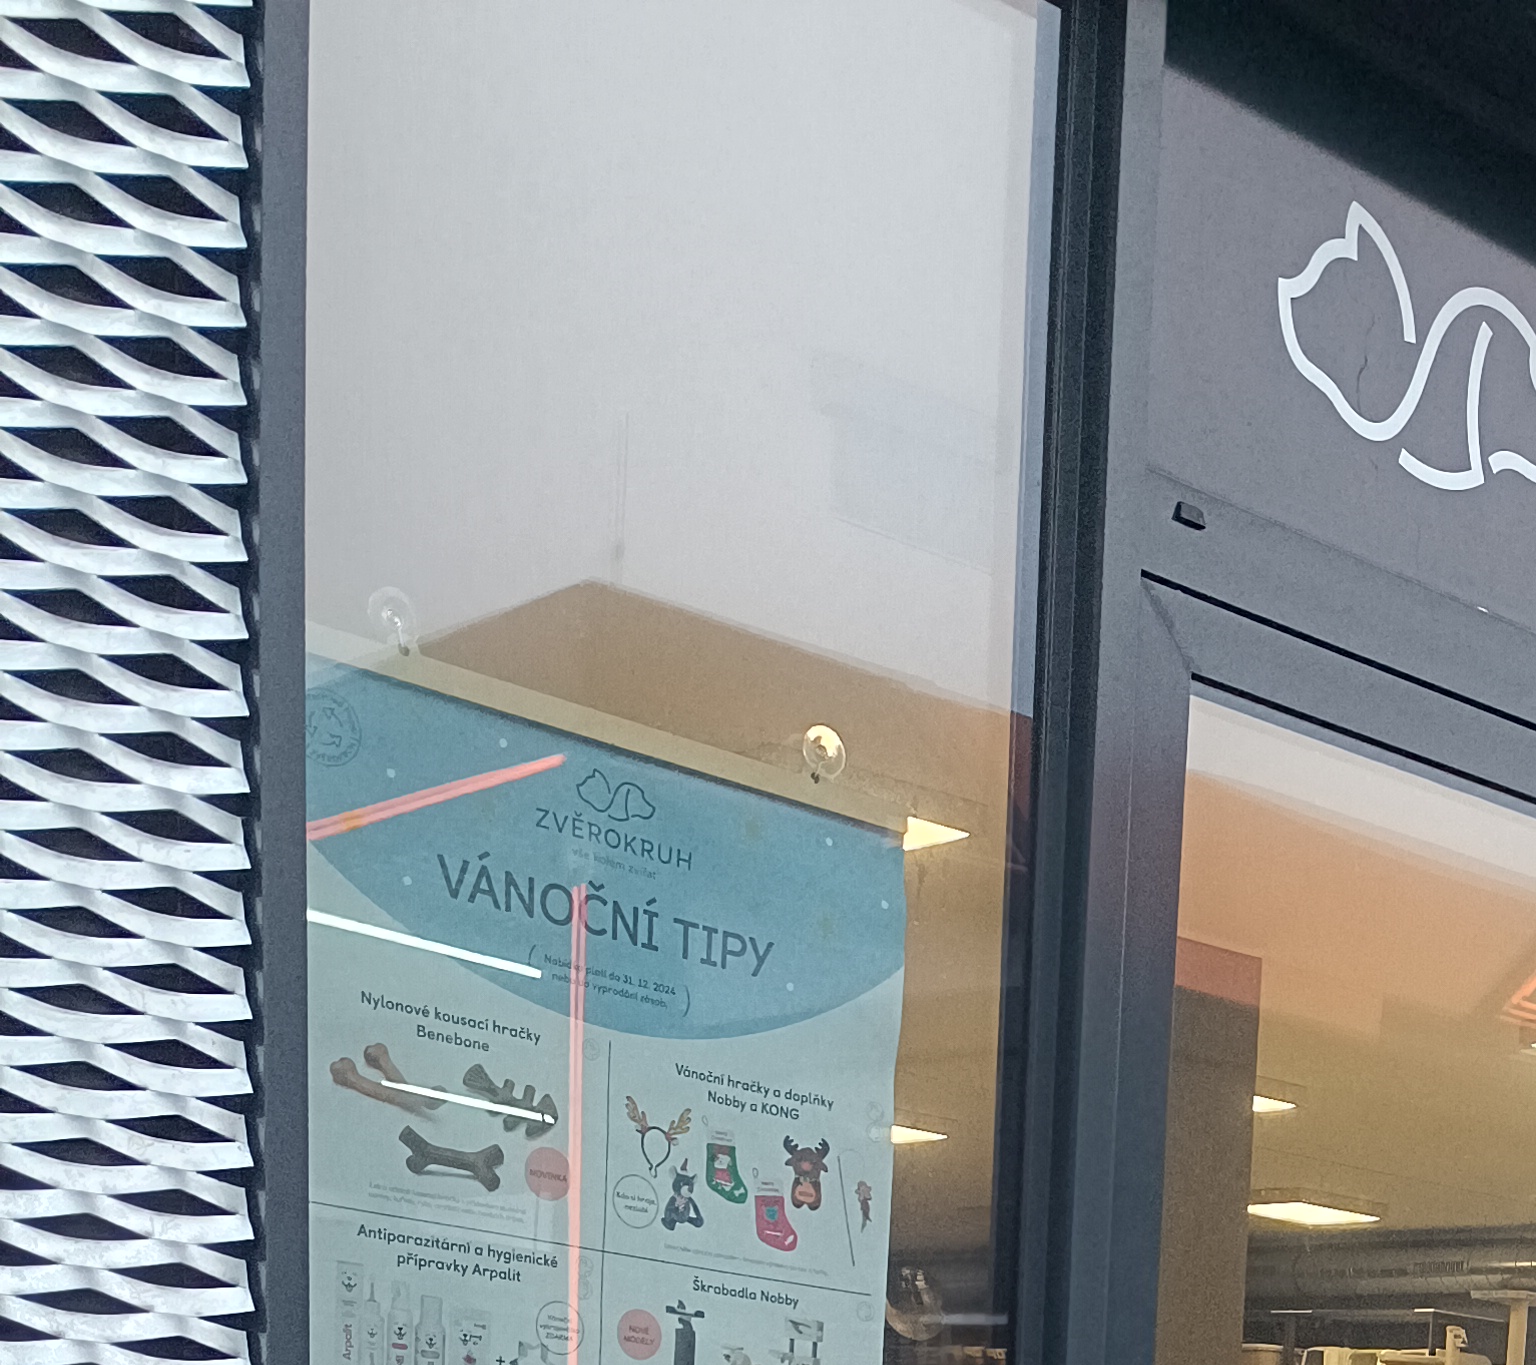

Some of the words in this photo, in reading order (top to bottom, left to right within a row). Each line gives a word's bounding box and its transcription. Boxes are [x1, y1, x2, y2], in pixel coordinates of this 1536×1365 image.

[534, 807, 693, 872] ZVĚROKRUH
[436, 851, 660, 952] VÁNOČNÍ
[673, 918, 775, 978] TIPY
[360, 990, 430, 1018] Nylonové
[434, 1005, 490, 1033] kousací
[492, 1019, 542, 1046] hračky
[416, 1024, 490, 1052] Benebone
[674, 1062, 725, 1087] Vánoční
[727, 1074, 771, 1099] hračky
[772, 1088, 782, 1099] a
[784, 1088, 835, 1112] doplňky
[707, 1090, 747, 1113] Nobby
[749, 1102, 759, 1112] a
[760, 1102, 800, 1121] KONG
[356, 1223, 471, 1255] Antiparazitární
[474, 1245, 484, 1256] a
[487, 1244, 559, 1269] hygienické
[396, 1251, 469, 1277] přípravky
[471, 1263, 522, 1283] Arpalit
[692, 1275, 757, 1302] Škrabadla
[760, 1289, 800, 1310] Nobby
